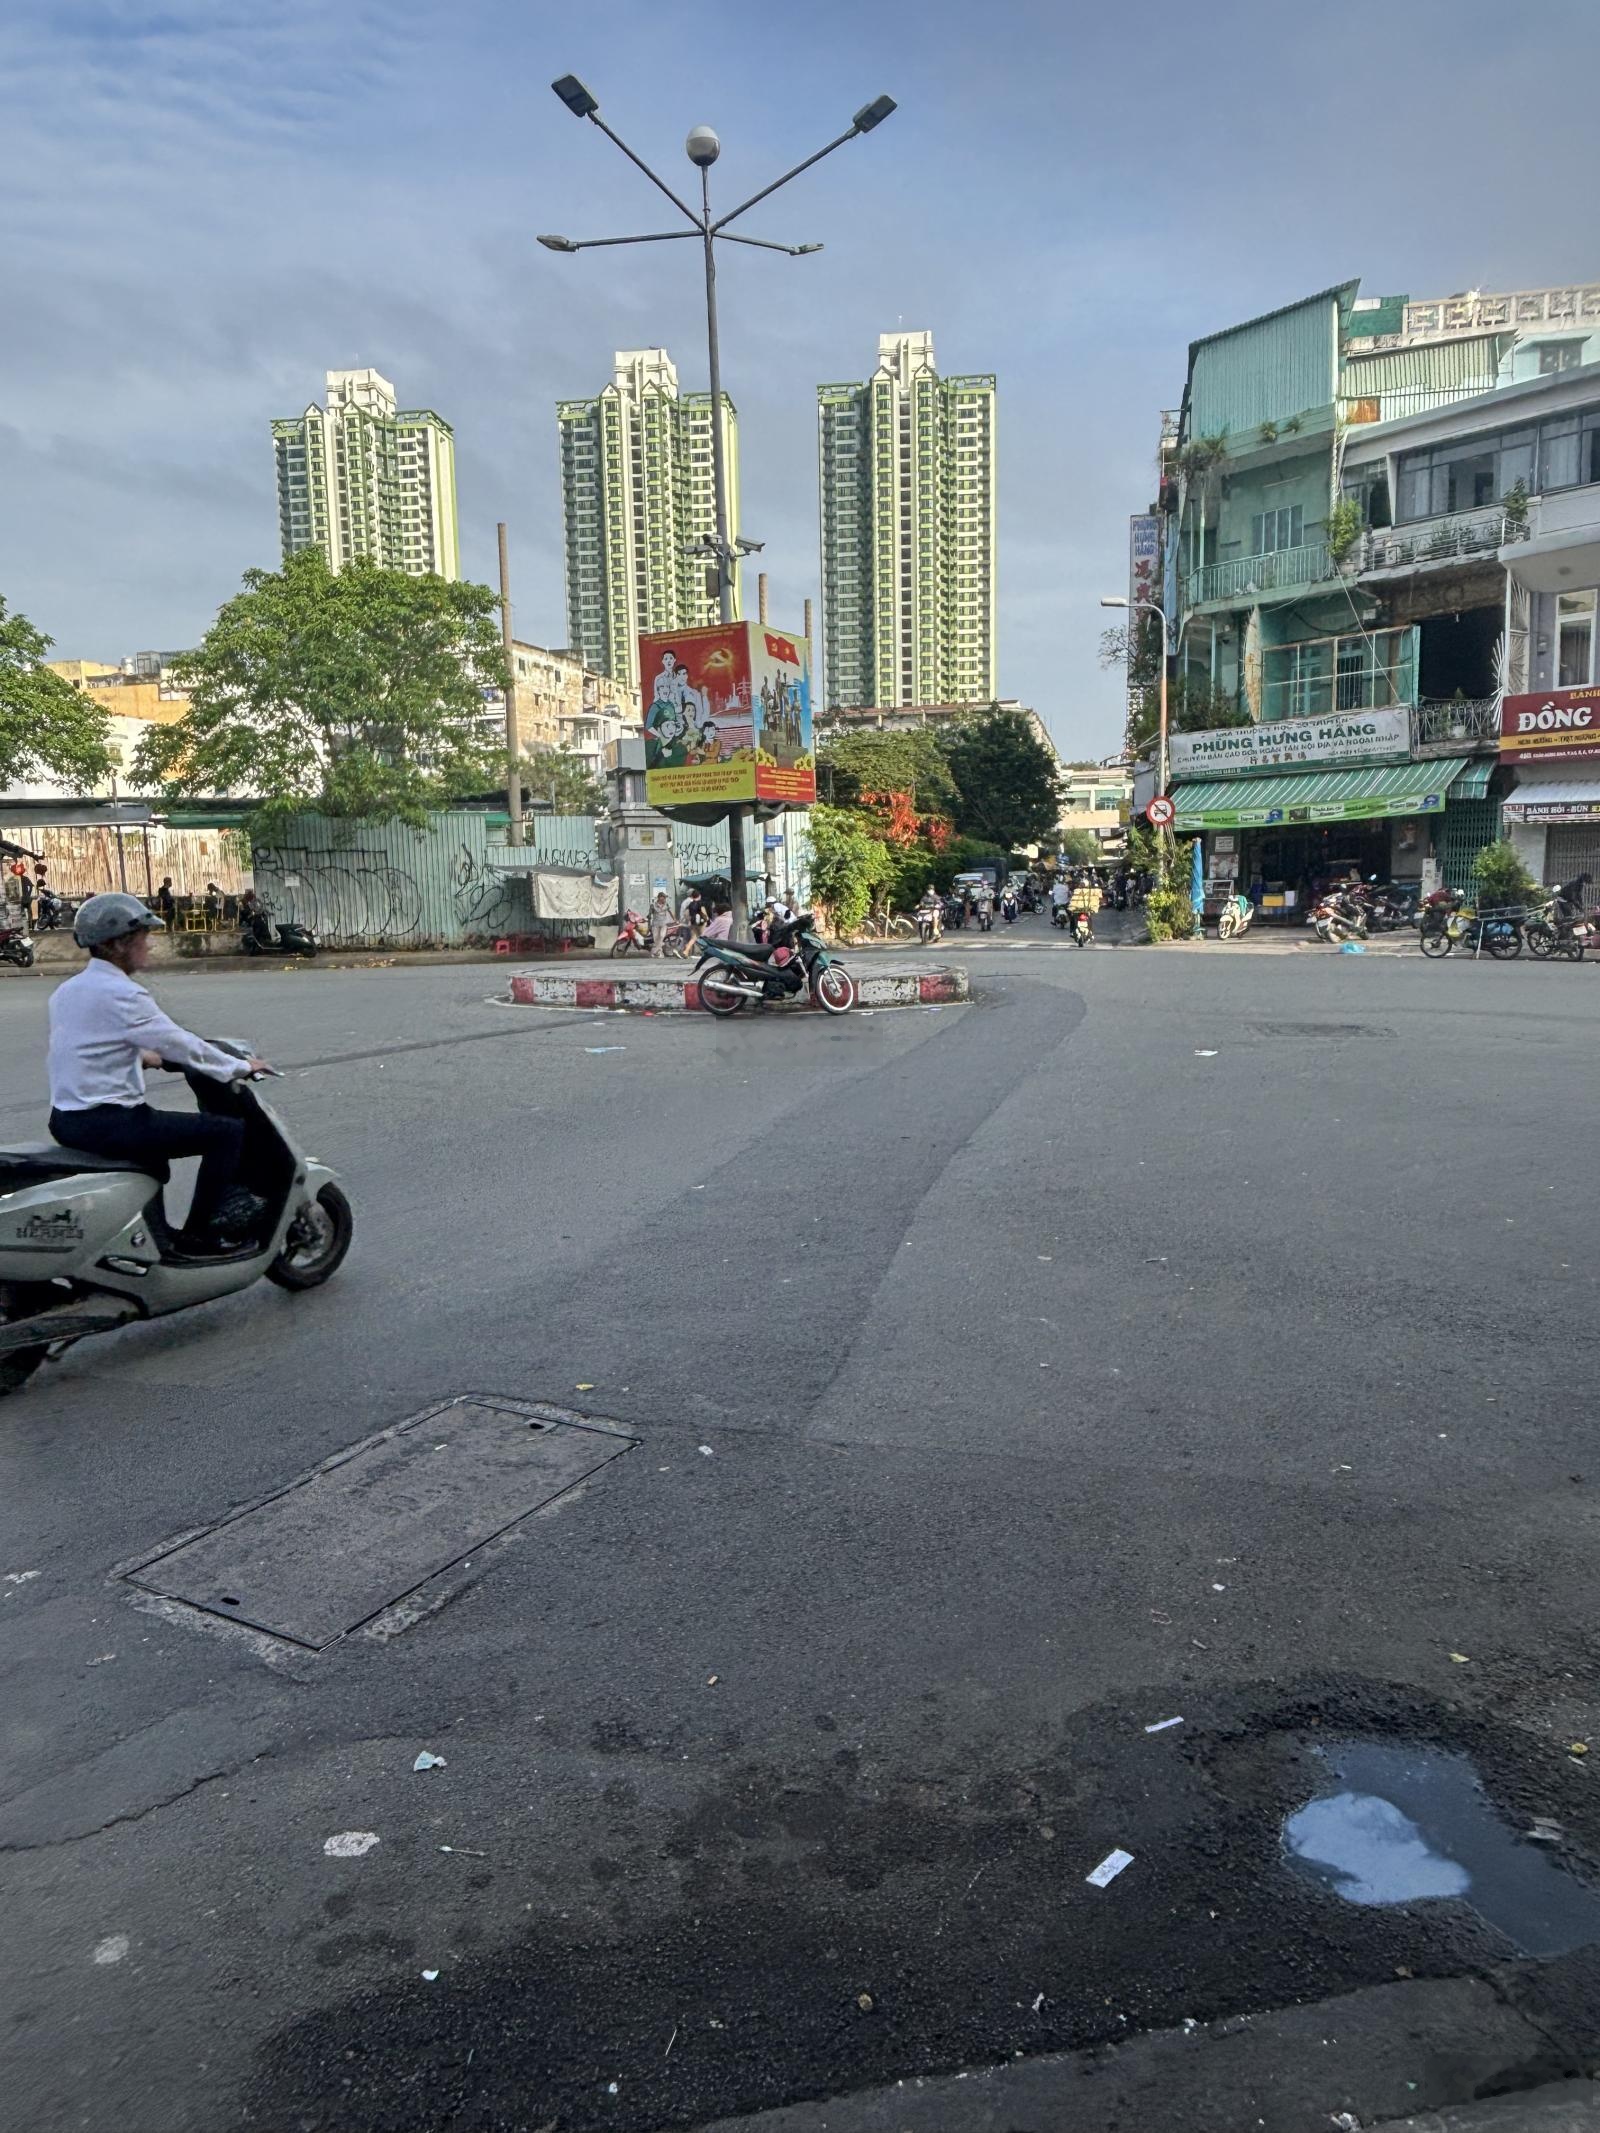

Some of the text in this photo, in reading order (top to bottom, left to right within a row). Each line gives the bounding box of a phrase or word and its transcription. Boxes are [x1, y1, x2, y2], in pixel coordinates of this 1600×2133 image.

[1518, 701, 1593, 731] ĐỒNG
[1192, 723, 1376, 754] PHÙNG HƯNG HẰNG
